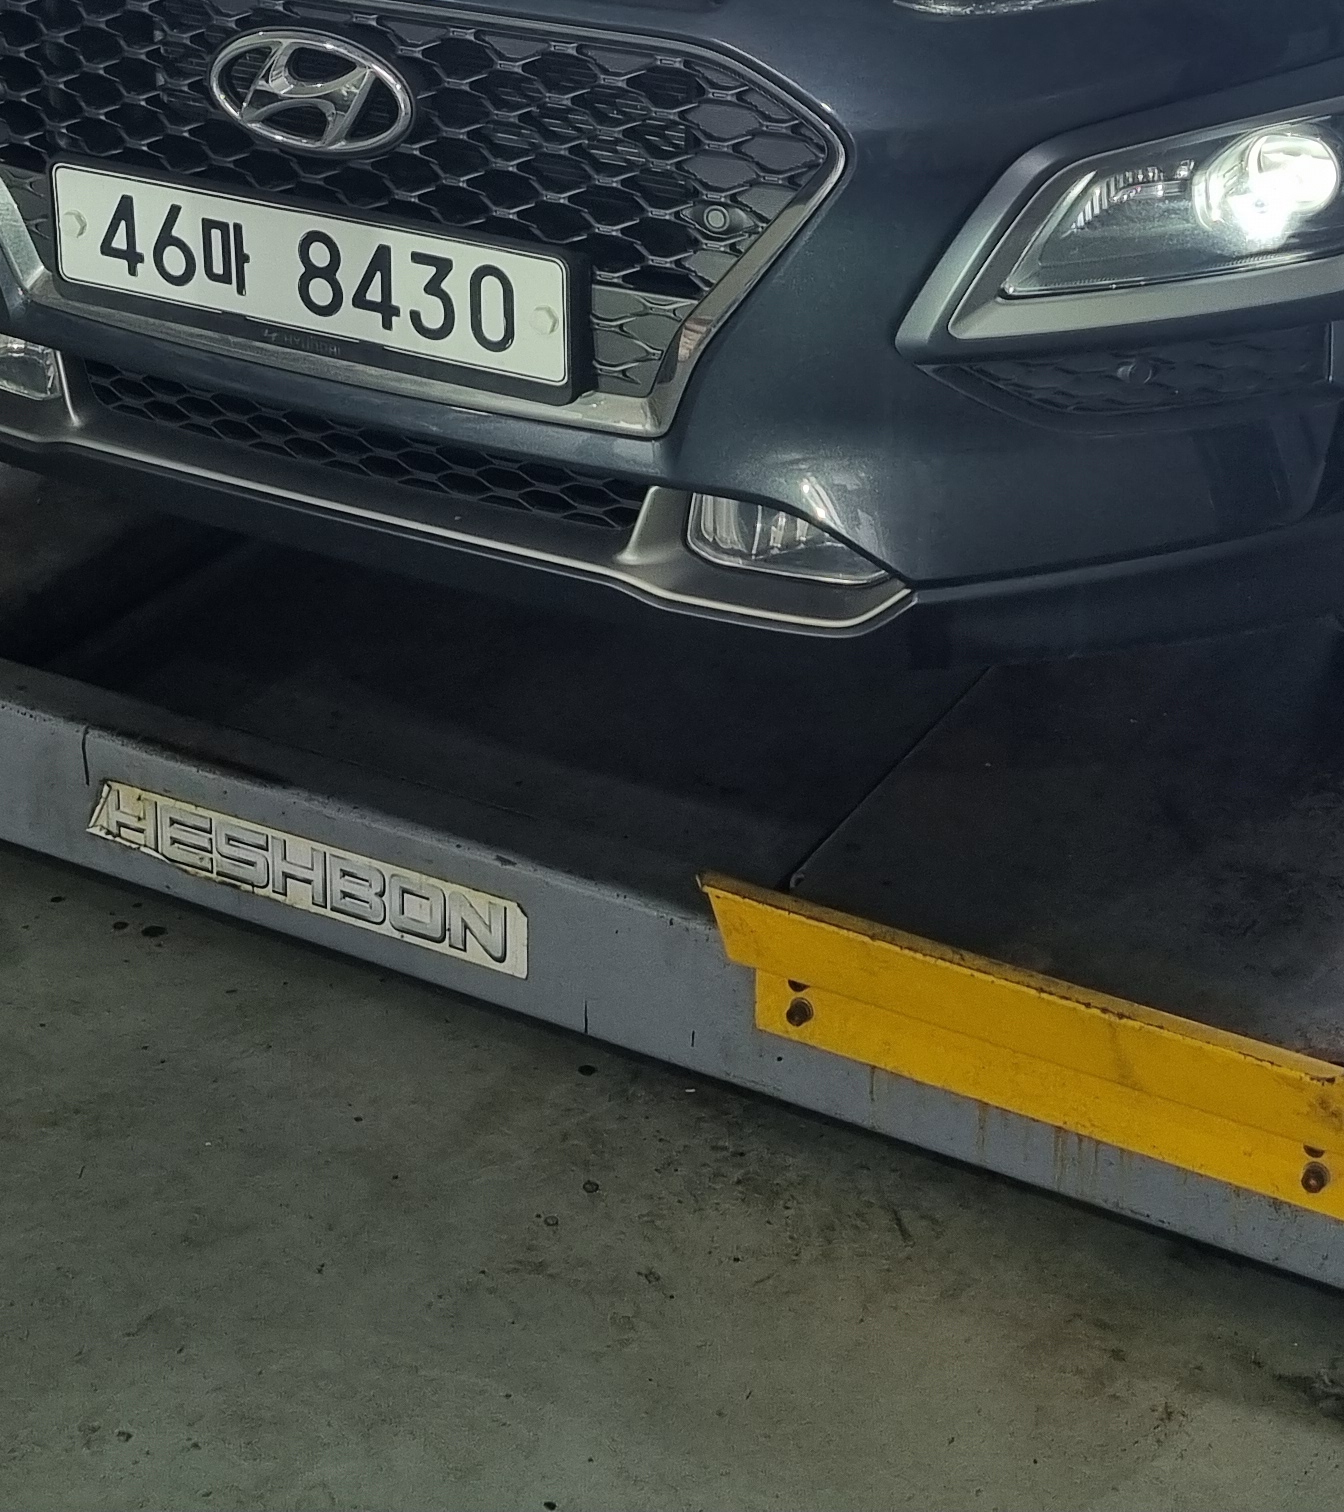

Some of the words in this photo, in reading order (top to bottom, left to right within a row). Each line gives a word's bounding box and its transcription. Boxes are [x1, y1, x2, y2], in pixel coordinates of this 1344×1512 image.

[100, 194, 250, 296] 46마
[297, 229, 516, 353] 8430
[106, 786, 508, 964] HESHBON
